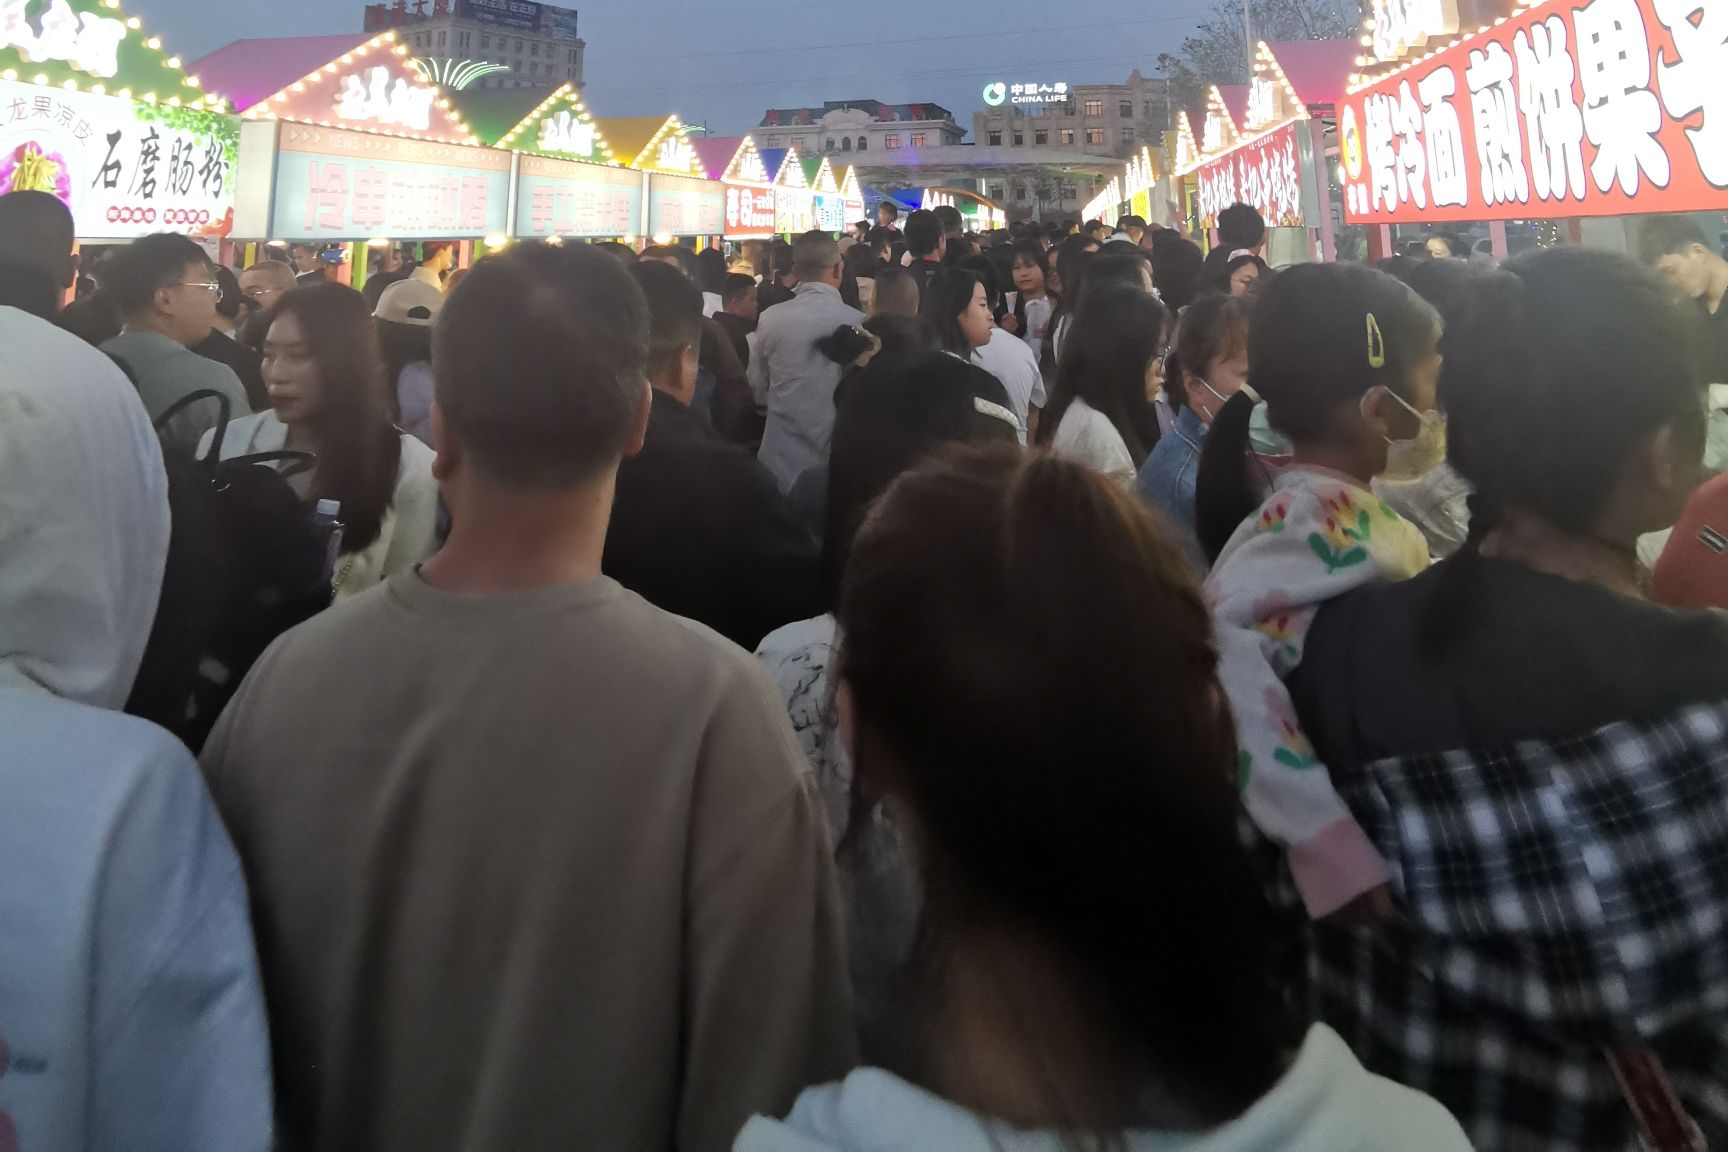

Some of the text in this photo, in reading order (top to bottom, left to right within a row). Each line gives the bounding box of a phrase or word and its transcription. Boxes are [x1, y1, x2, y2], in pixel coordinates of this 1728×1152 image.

[1010, 82, 1067, 95] 中国人寿
[1045, 94, 1067, 102] LIFE
[0, 95, 94, 147] 龙果凉皮
[328, 134, 360, 150] NEWS
[1364, 66, 1467, 214] 烤冷面
[92, 126, 229, 199] 石磨肠粉
